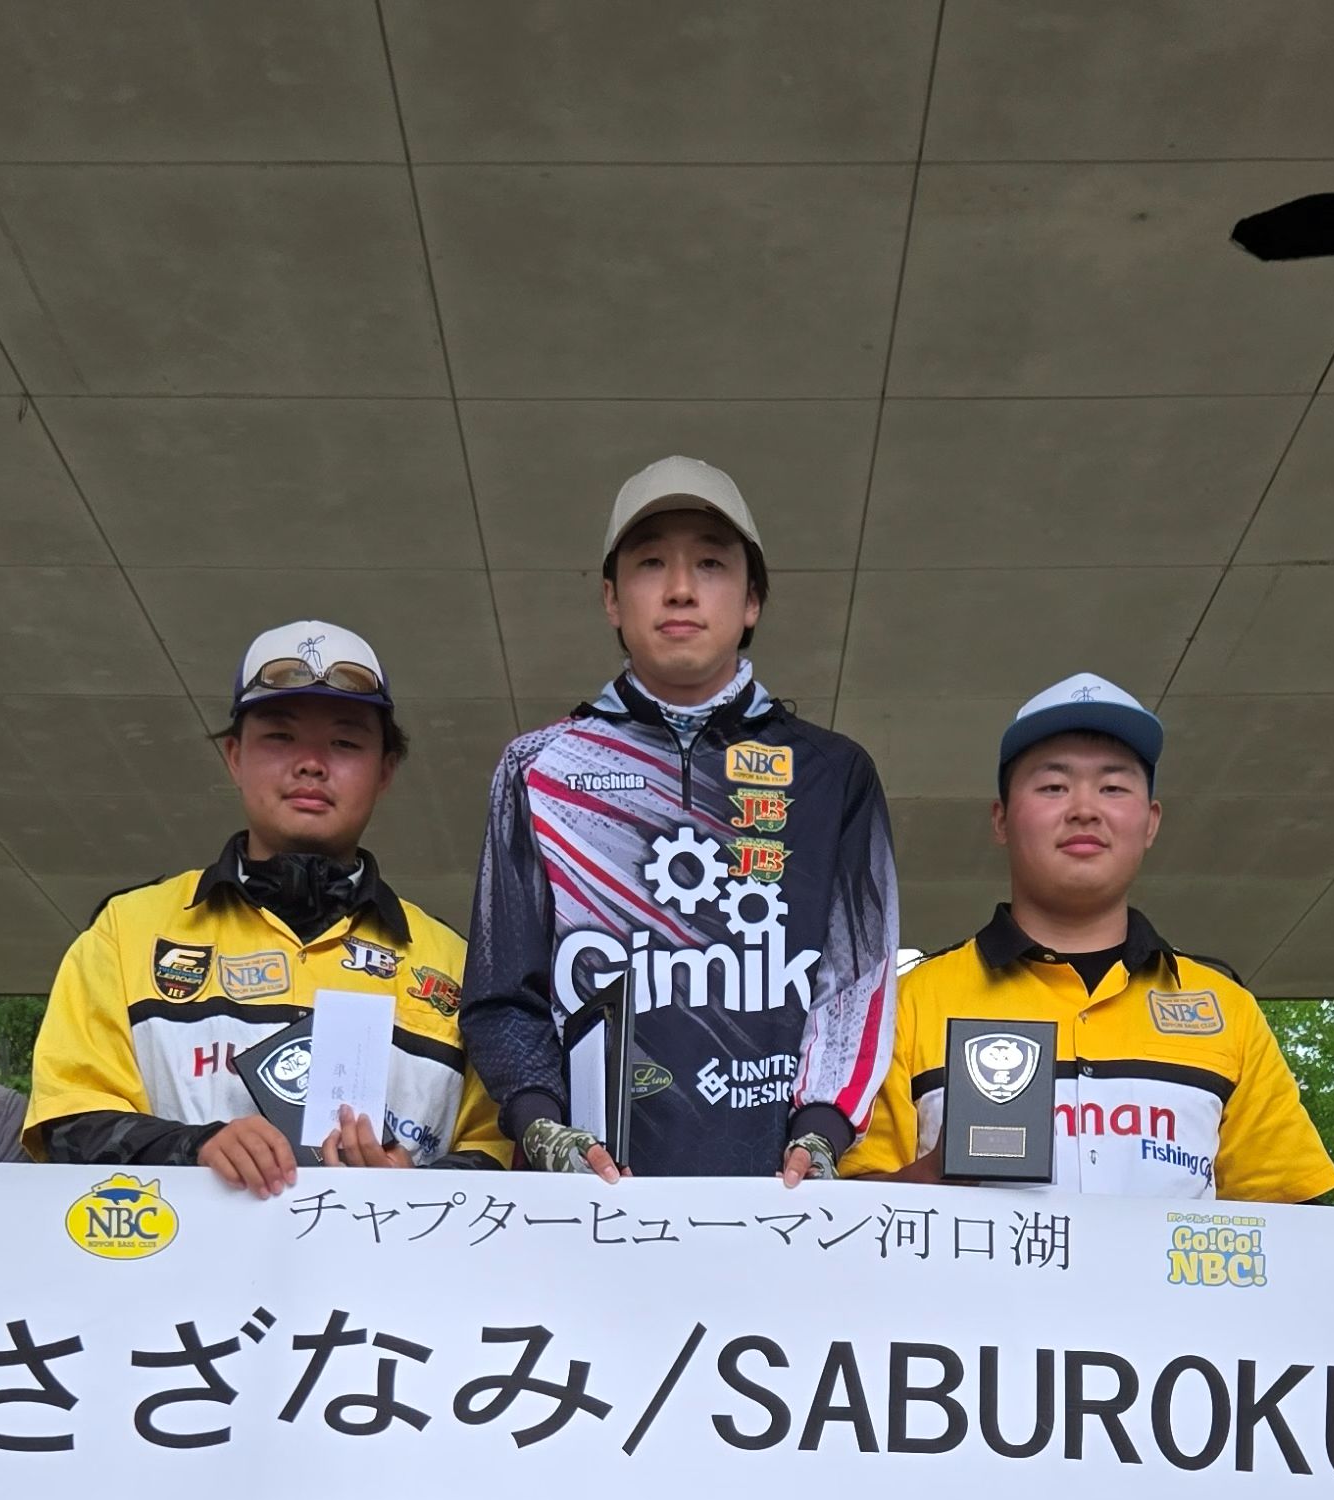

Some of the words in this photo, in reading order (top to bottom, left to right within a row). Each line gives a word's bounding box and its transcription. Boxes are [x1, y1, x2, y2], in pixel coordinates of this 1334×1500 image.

[733, 749, 787, 776] NBC
[731, 796, 787, 828] JB
[728, 845, 785, 877] JB
[224, 961, 283, 986] NBC
[341, 943, 398, 972] JB
[553, 926, 822, 1015] Gimik
[1156, 1001, 1215, 1022] NBC
[731, 1054, 798, 1082] UNITE
[1054, 1102, 1176, 1141] man
[1142, 1139, 1199, 1175] Fishing
[85, 1206, 159, 1240] NBC
[289, 1188, 1073, 1271] チャプターヒューマン河口湖
[1167, 1250, 1267, 1287] NBC!
